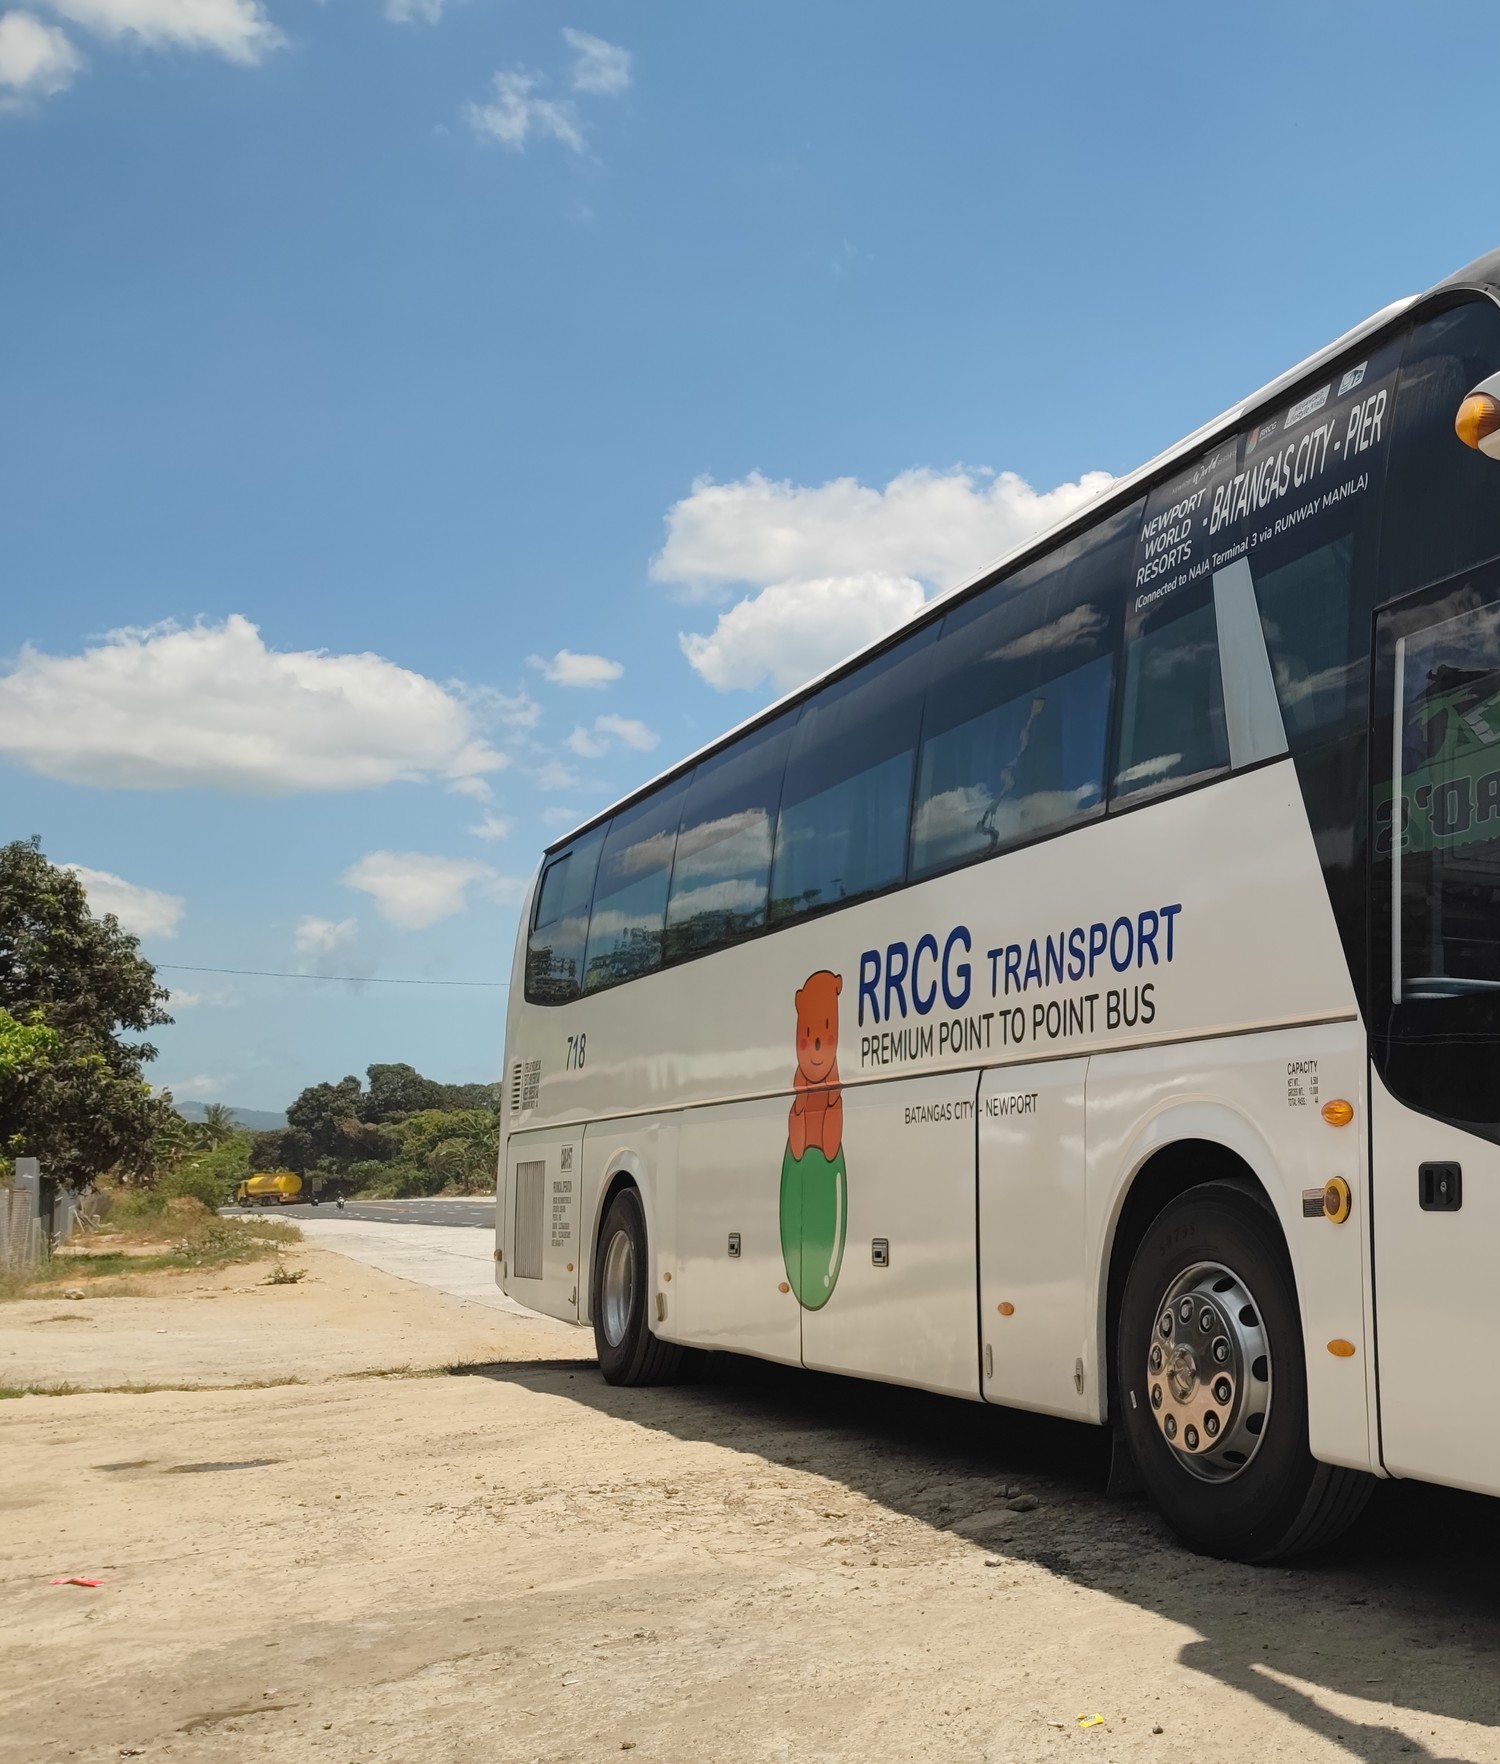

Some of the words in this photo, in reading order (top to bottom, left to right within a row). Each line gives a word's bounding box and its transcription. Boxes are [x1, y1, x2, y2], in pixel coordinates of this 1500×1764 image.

[1209, 443, 1295, 535] BATANGAS
[1294, 419, 1336, 487] CITY
[1344, 389, 1387, 461] PIER
[1140, 488, 1206, 542] NEWPORT
[1144, 519, 1191, 560] WORLD
[1135, 576, 1177, 612] (Connected
[1178, 573, 1187, 585] to
[1188, 561, 1210, 580] NAIA
[1211, 537, 1249, 568] Terminal
[1251, 532, 1258, 547] 3
[1259, 526, 1272, 542] via
[1274, 498, 1322, 535] RUNWAY
[1322, 472, 1369, 508] MANILA)
[1136, 540, 1192, 587] RESORTS
[858, 926, 972, 1027] RRCG
[987, 903, 1182, 998] TRANSPORT
[861, 1024, 934, 1068] PREMIUM
[940, 1012, 994, 1055] POINT
[999, 1007, 1025, 1045] TO
[1033, 993, 1099, 1041] POINT
[1106, 983, 1156, 1030] BUS
[566, 1033, 587, 1071] 718
[1287, 1060, 1317, 1075] CAPACITY
[905, 1102, 952, 1125] BATANGAS
[954, 1100, 975, 1120] CITY
[985, 1093, 1038, 1117] NEWPORT
